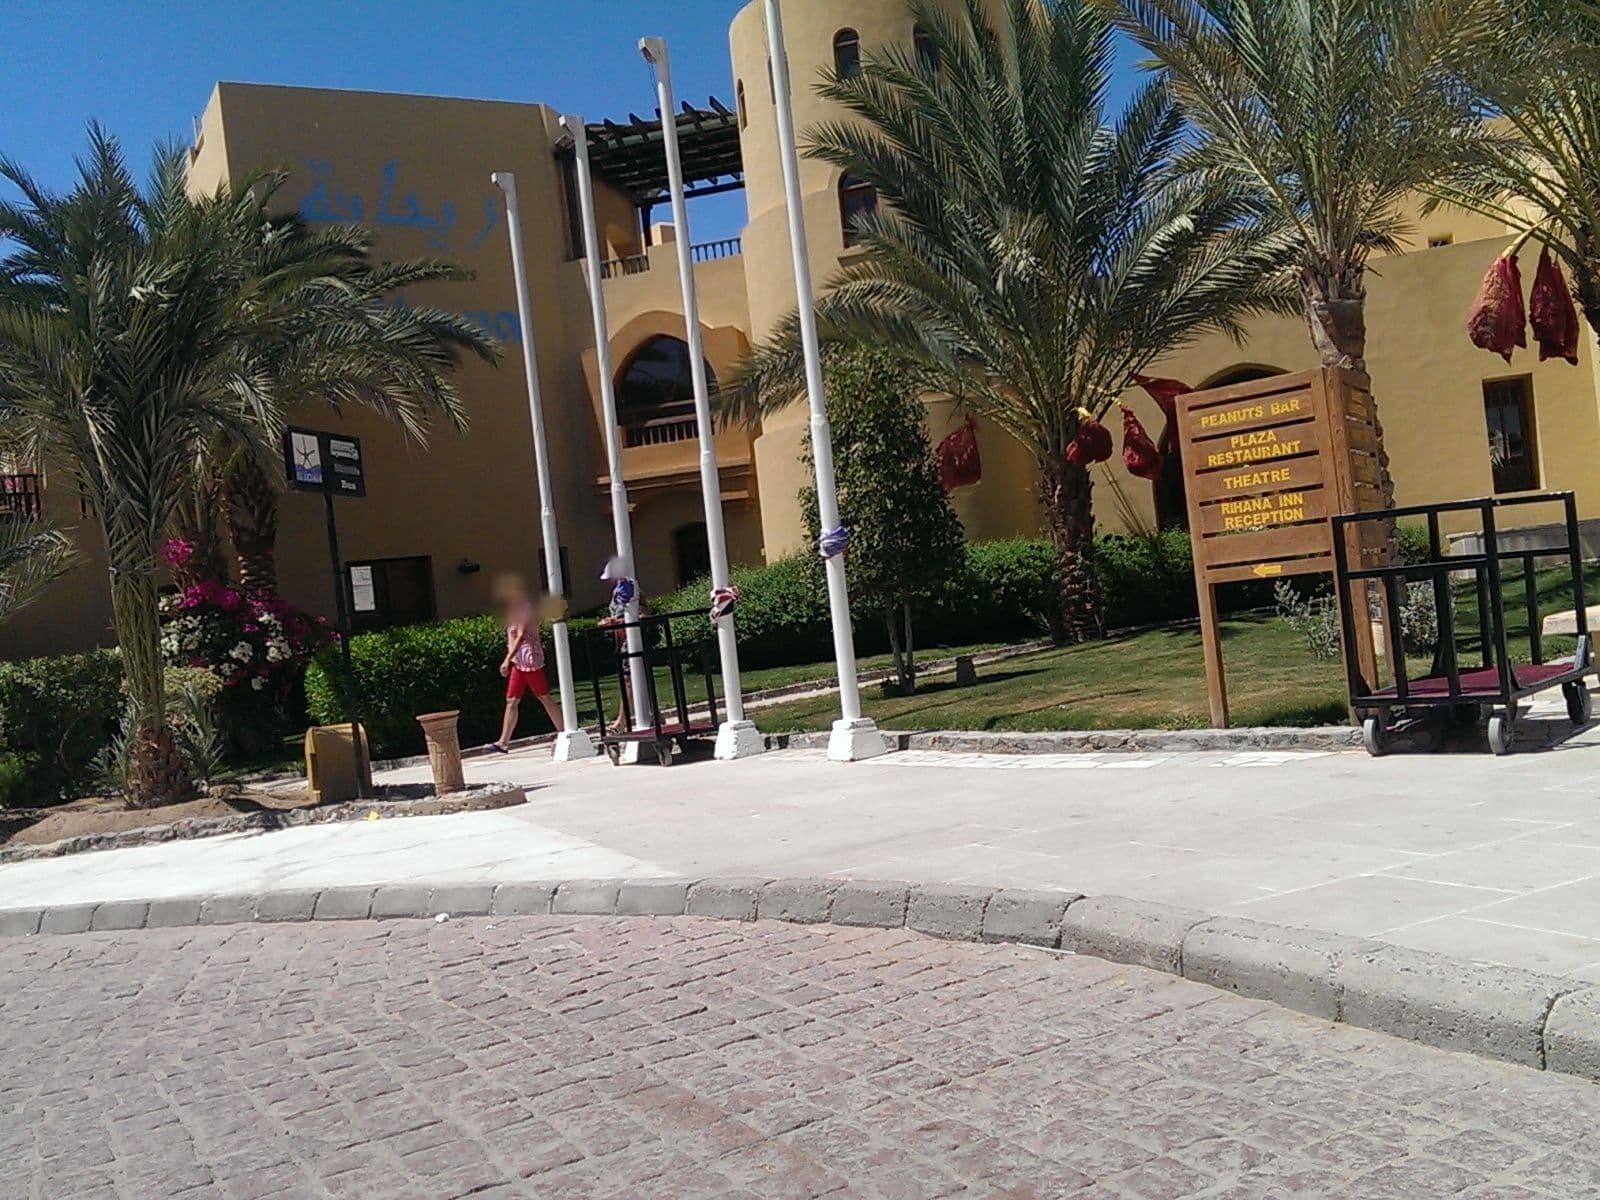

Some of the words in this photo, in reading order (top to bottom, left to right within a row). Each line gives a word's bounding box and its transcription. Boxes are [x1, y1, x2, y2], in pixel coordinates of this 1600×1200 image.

[1201, 405, 1264, 428] PEANUTS
[1270, 400, 1300, 416] BAR
[1230, 430, 1277, 448] PLAZA
[1208, 440, 1301, 467] RESTAURANT
[1223, 468, 1290, 490] THEATRE
[1221, 498, 1273, 515] RIHANA
[1278, 493, 1304, 506] INN
[1224, 508, 1304, 530] RECEPTION
